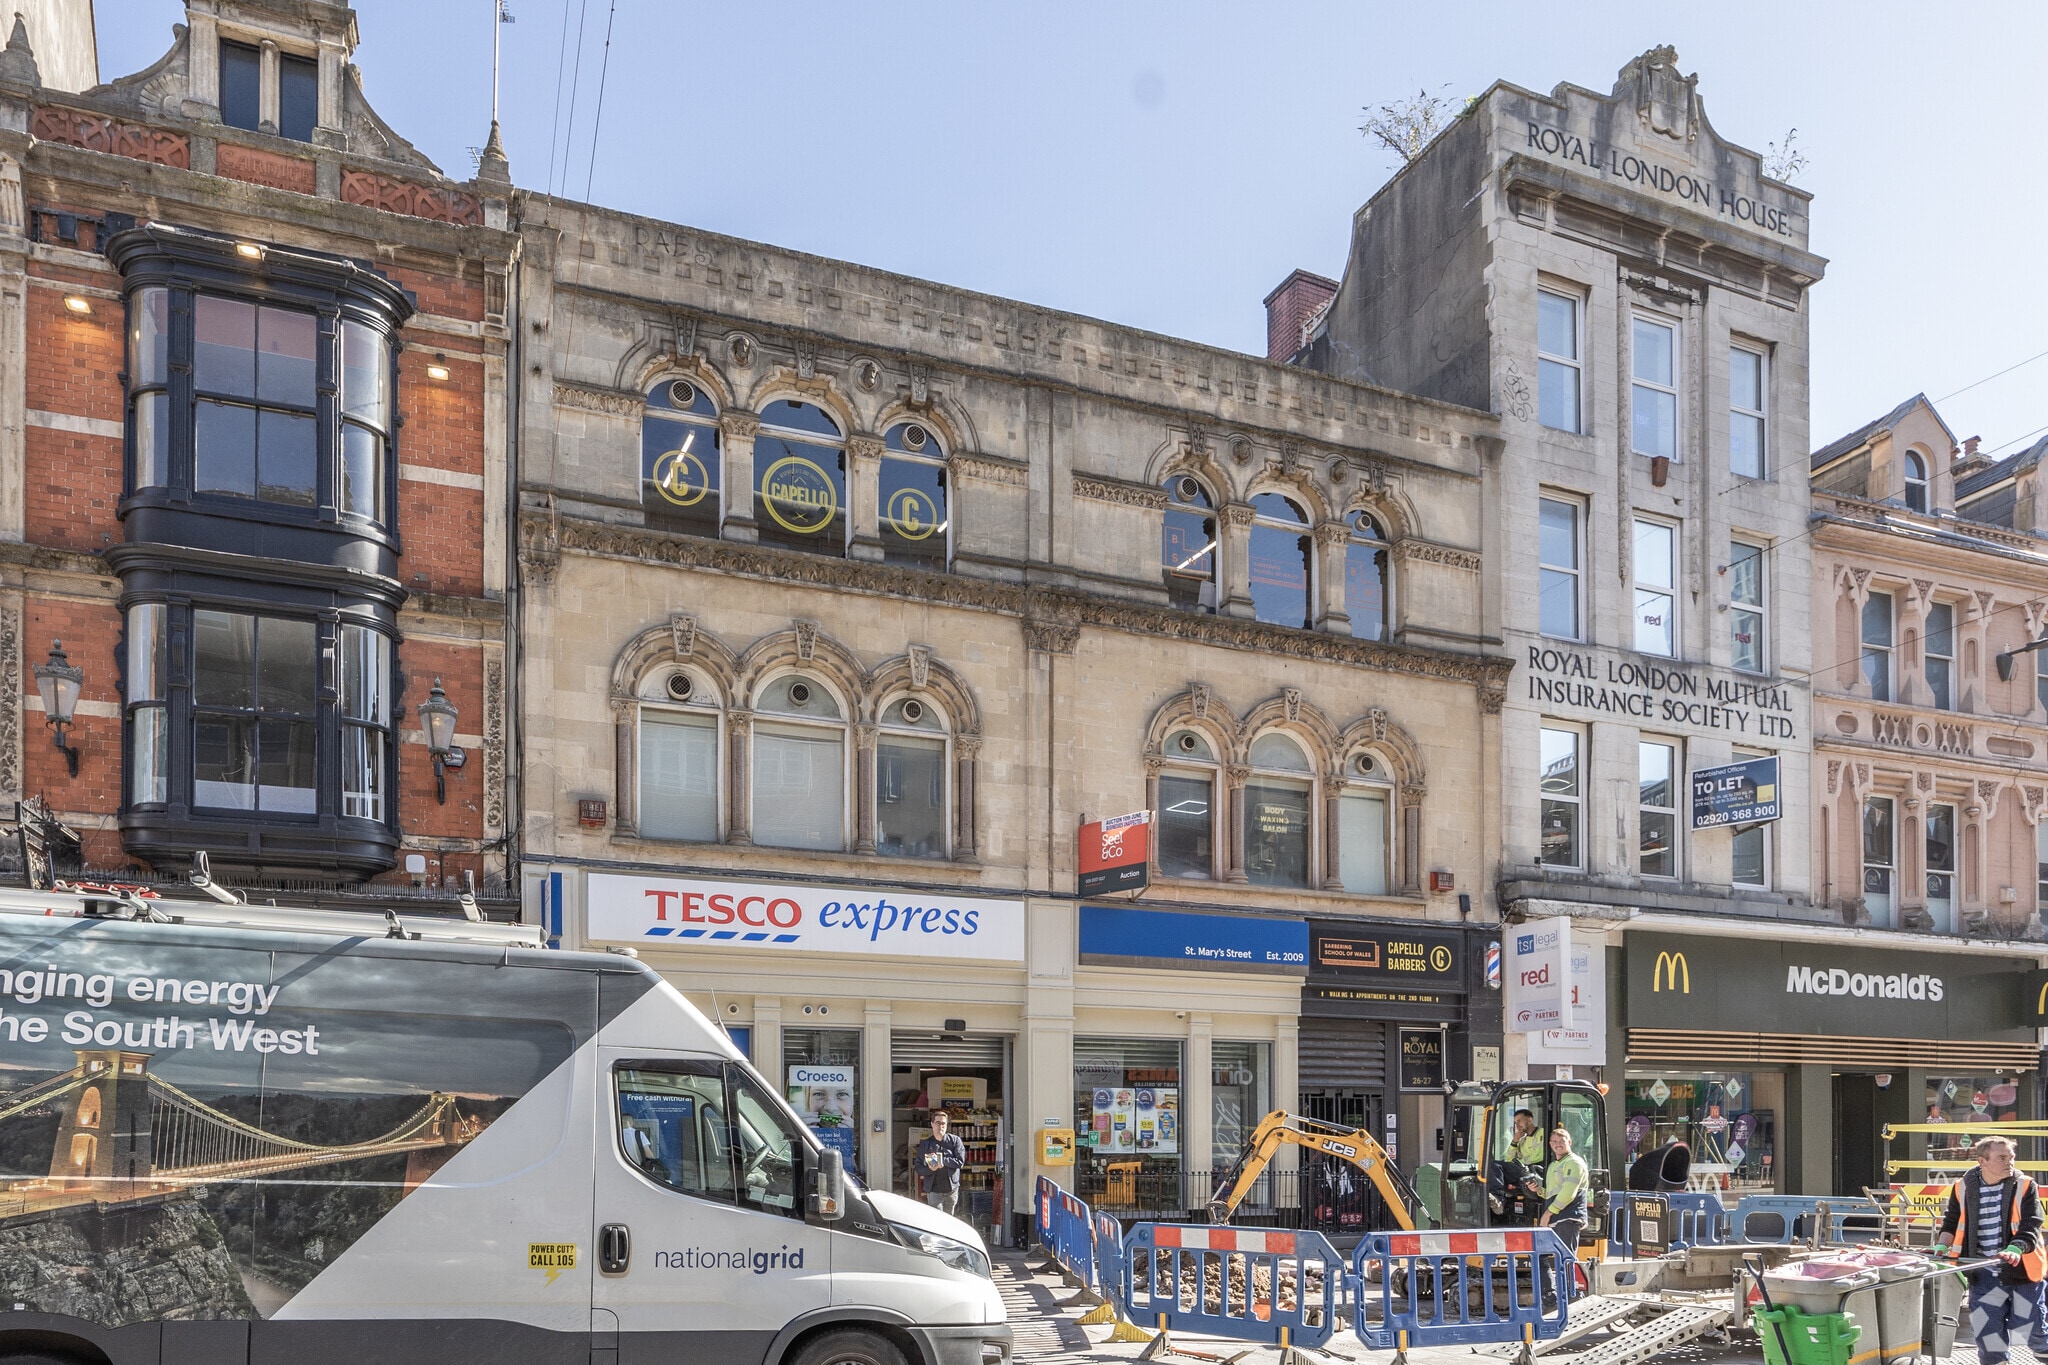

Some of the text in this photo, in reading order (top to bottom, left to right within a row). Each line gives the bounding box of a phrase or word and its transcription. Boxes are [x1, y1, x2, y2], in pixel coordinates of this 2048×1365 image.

[221, 149, 310, 182] CARDIFF
[1528, 122, 1600, 169] ROYAL
[1612, 150, 1711, 207] LONDON
[771, 482, 829, 507] CAPELLO
[1644, 615, 1661, 627] red
[1735, 633, 1752, 644] red
[1528, 646, 1793, 712] ROYAL LONDON MUTUAL
[1528, 676, 1797, 740] INSURANCE SOCIETY LTD.
[1695, 766, 1746, 779] Refurbished Offices
[1695, 776, 1744, 795] TO LET
[1264, 806, 1286, 815] BODY
[1696, 805, 1775, 826] 02920 368 900
[1262, 824, 1288, 834] SALON
[1102, 831, 1123, 847] Seel
[1102, 846, 1123, 860] &Co
[1120, 870, 1140, 879] Auction
[645, 890, 979, 942] TESCO express
[1518, 930, 1558, 952] tsr legal
[1185, 946, 1252, 959] St. Mary's Street
[1324, 949, 1346, 957] SCHOOL
[1387, 942, 1424, 956] CAPELLO
[1266, 951, 1304, 962] Est. 2009
[1387, 958, 1427, 972] BARBERS
[1521, 963, 1549, 987] red
[1786, 965, 1943, 1002] McDonald's
[127, 977, 280, 1015] energy
[1535, 1010, 1559, 1019] PARTNER
[61, 1011, 194, 1050] South
[209, 1017, 320, 1055] West
[1565, 1031, 1589, 1039] PARTNER
[1403, 1042, 1440, 1055] ROYAL
[1476, 1051, 1497, 1059] ROYAL
[796, 1070, 848, 1082] Croeso.
[1412, 1077, 1432, 1085] 26-27
[1322, 1138, 1356, 1157] JCB
[1635, 1201, 1661, 1213] CAPELLO
[530, 1245, 574, 1254] POWER CUT?
[530, 1254, 574, 1266] CALL 105
[655, 1244, 804, 1275] nationalgrid
